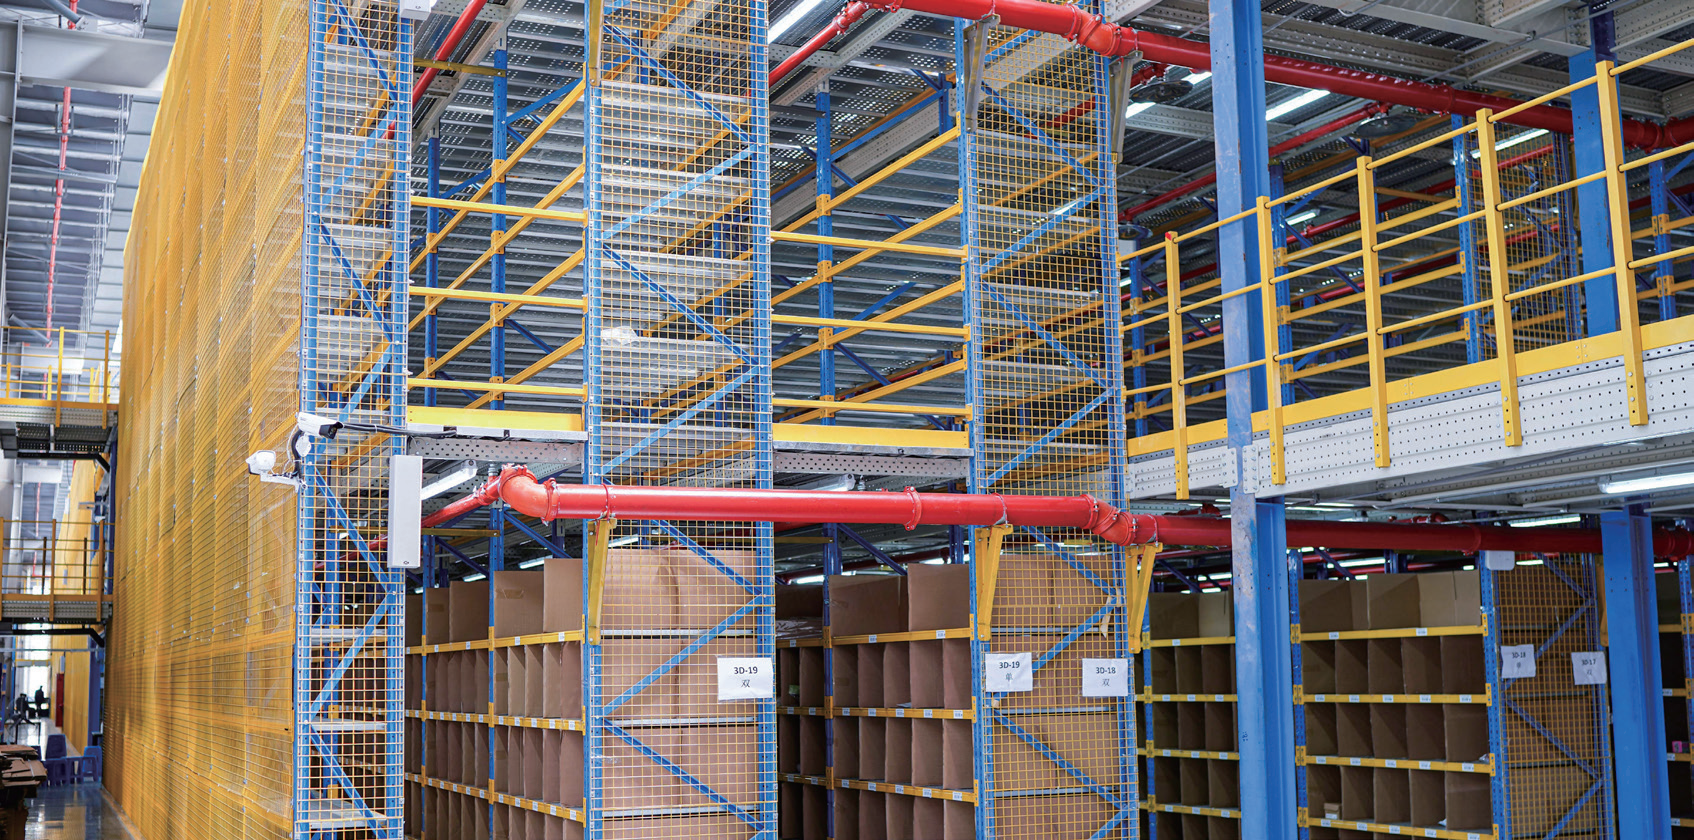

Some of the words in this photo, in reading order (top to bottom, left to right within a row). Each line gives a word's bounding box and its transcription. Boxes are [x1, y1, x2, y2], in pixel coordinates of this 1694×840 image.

[998, 661, 1020, 669] 3D-19
[734, 666, 758, 674] 3D-19
[741, 680, 750, 688] 双
